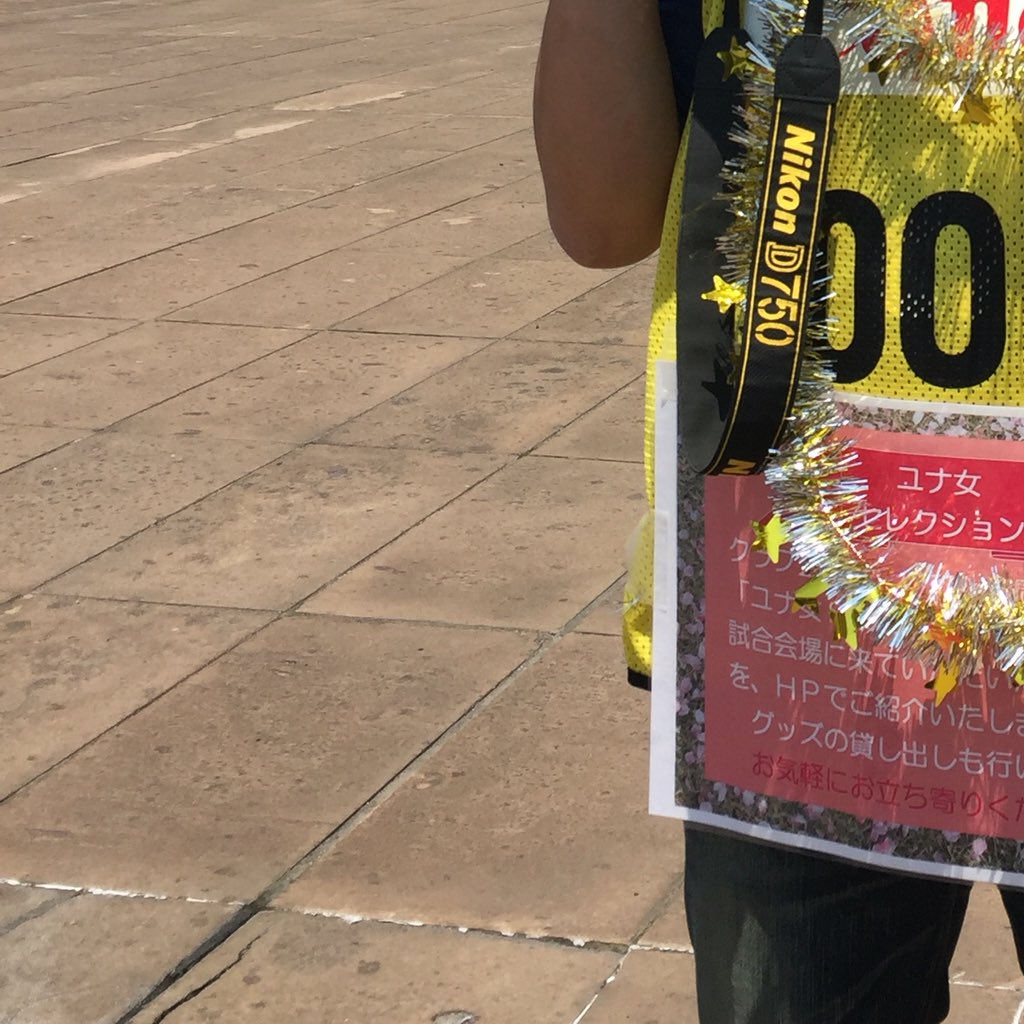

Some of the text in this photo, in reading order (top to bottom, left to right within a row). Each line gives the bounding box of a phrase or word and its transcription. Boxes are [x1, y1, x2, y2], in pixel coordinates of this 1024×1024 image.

[754, 124, 816, 347] Nikon D750
[896, 465, 982, 497] ユナ女
